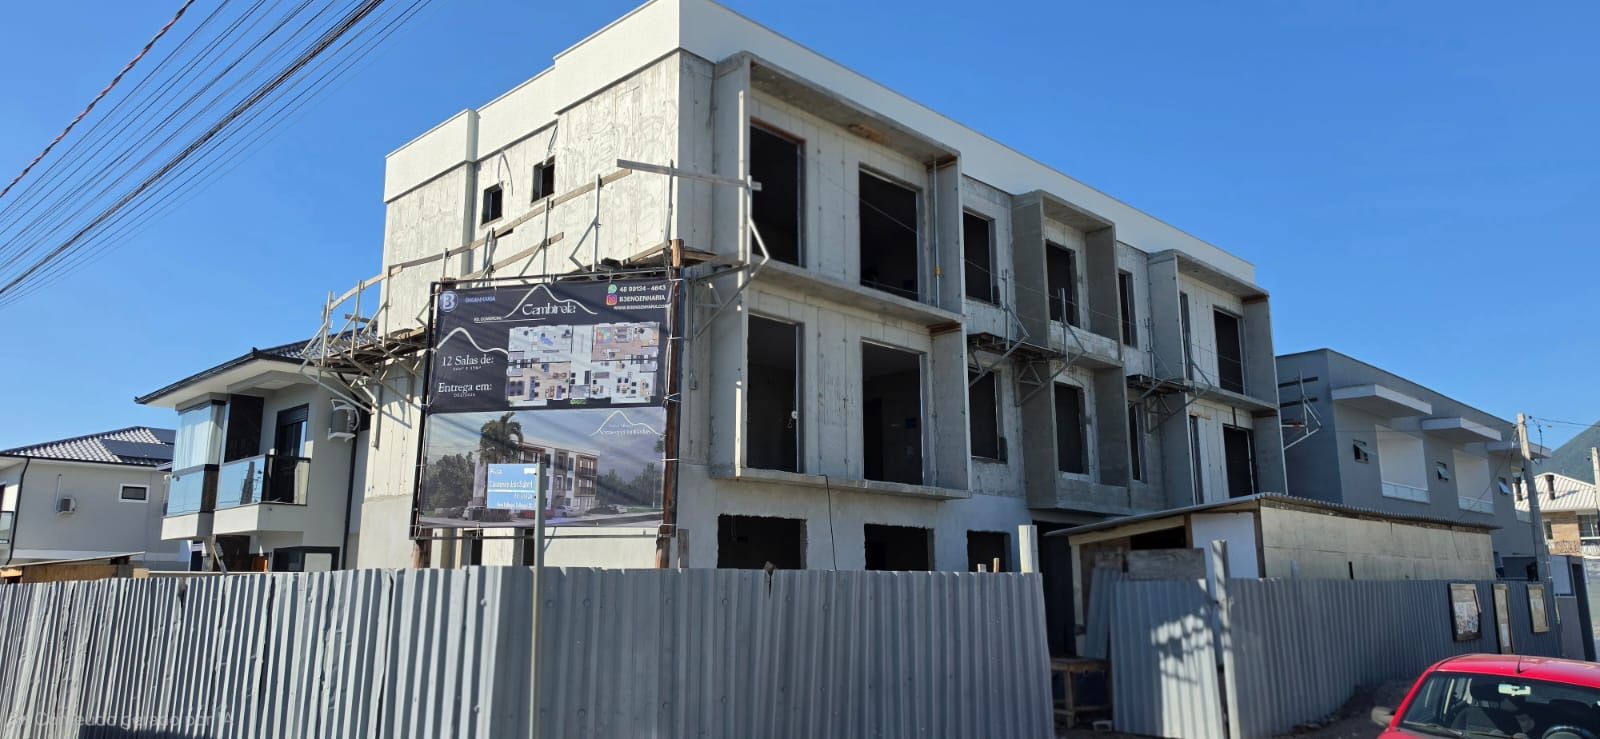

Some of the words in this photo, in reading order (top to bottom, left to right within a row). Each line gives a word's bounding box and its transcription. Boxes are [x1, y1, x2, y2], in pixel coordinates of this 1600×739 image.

[442, 356, 453, 366] 12
[454, 354, 478, 366] Salas
[480, 353, 494, 365] de:
[438, 382, 473, 393] Entrega
[475, 383, 492, 392] em:
